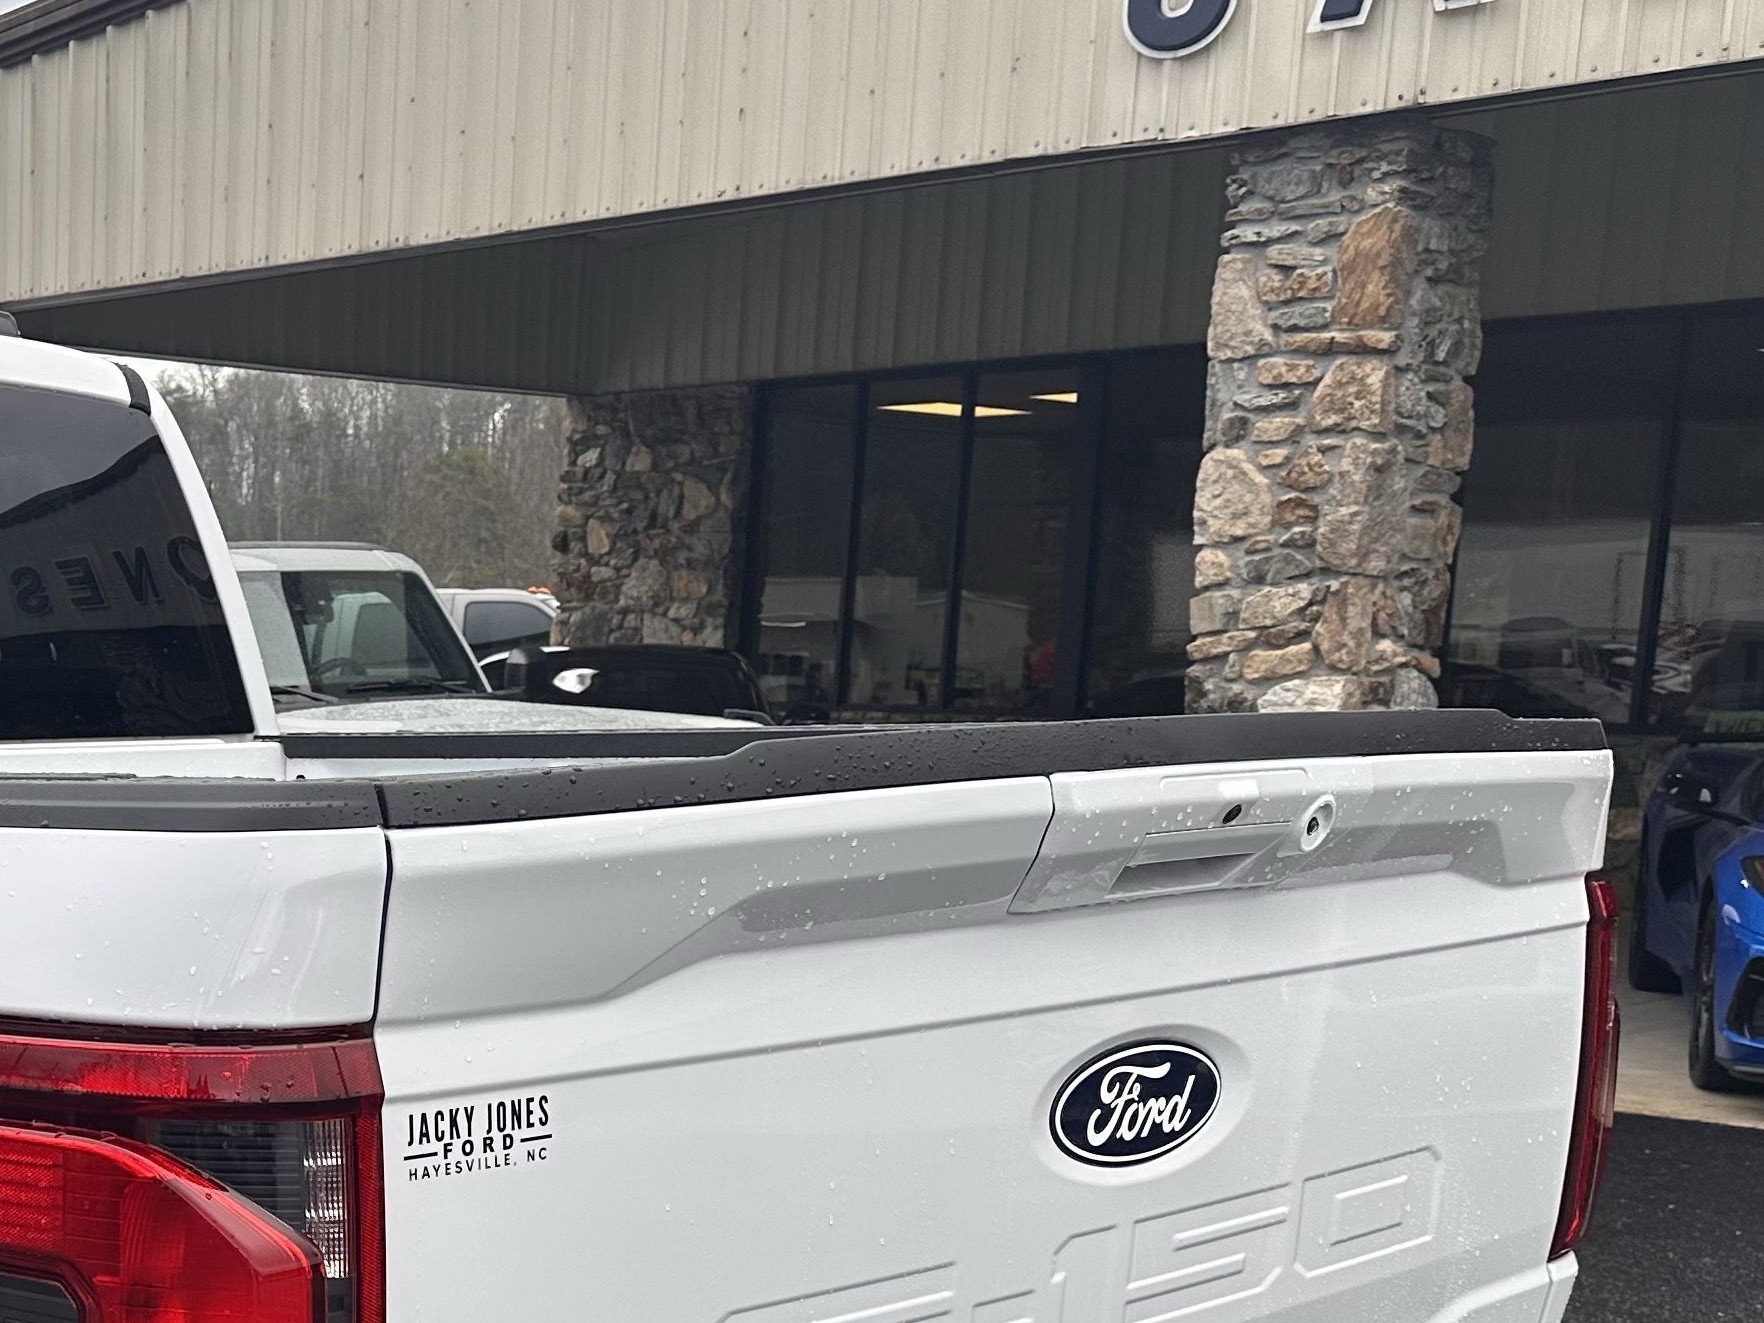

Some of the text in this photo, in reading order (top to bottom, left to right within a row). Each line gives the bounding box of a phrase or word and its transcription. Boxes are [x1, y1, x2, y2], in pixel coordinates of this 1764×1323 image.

[407, 1094, 550, 1147] JACKY JONES
[442, 1132, 515, 1161] FORD
[408, 1147, 548, 1182] HAYESVILLE, NC
